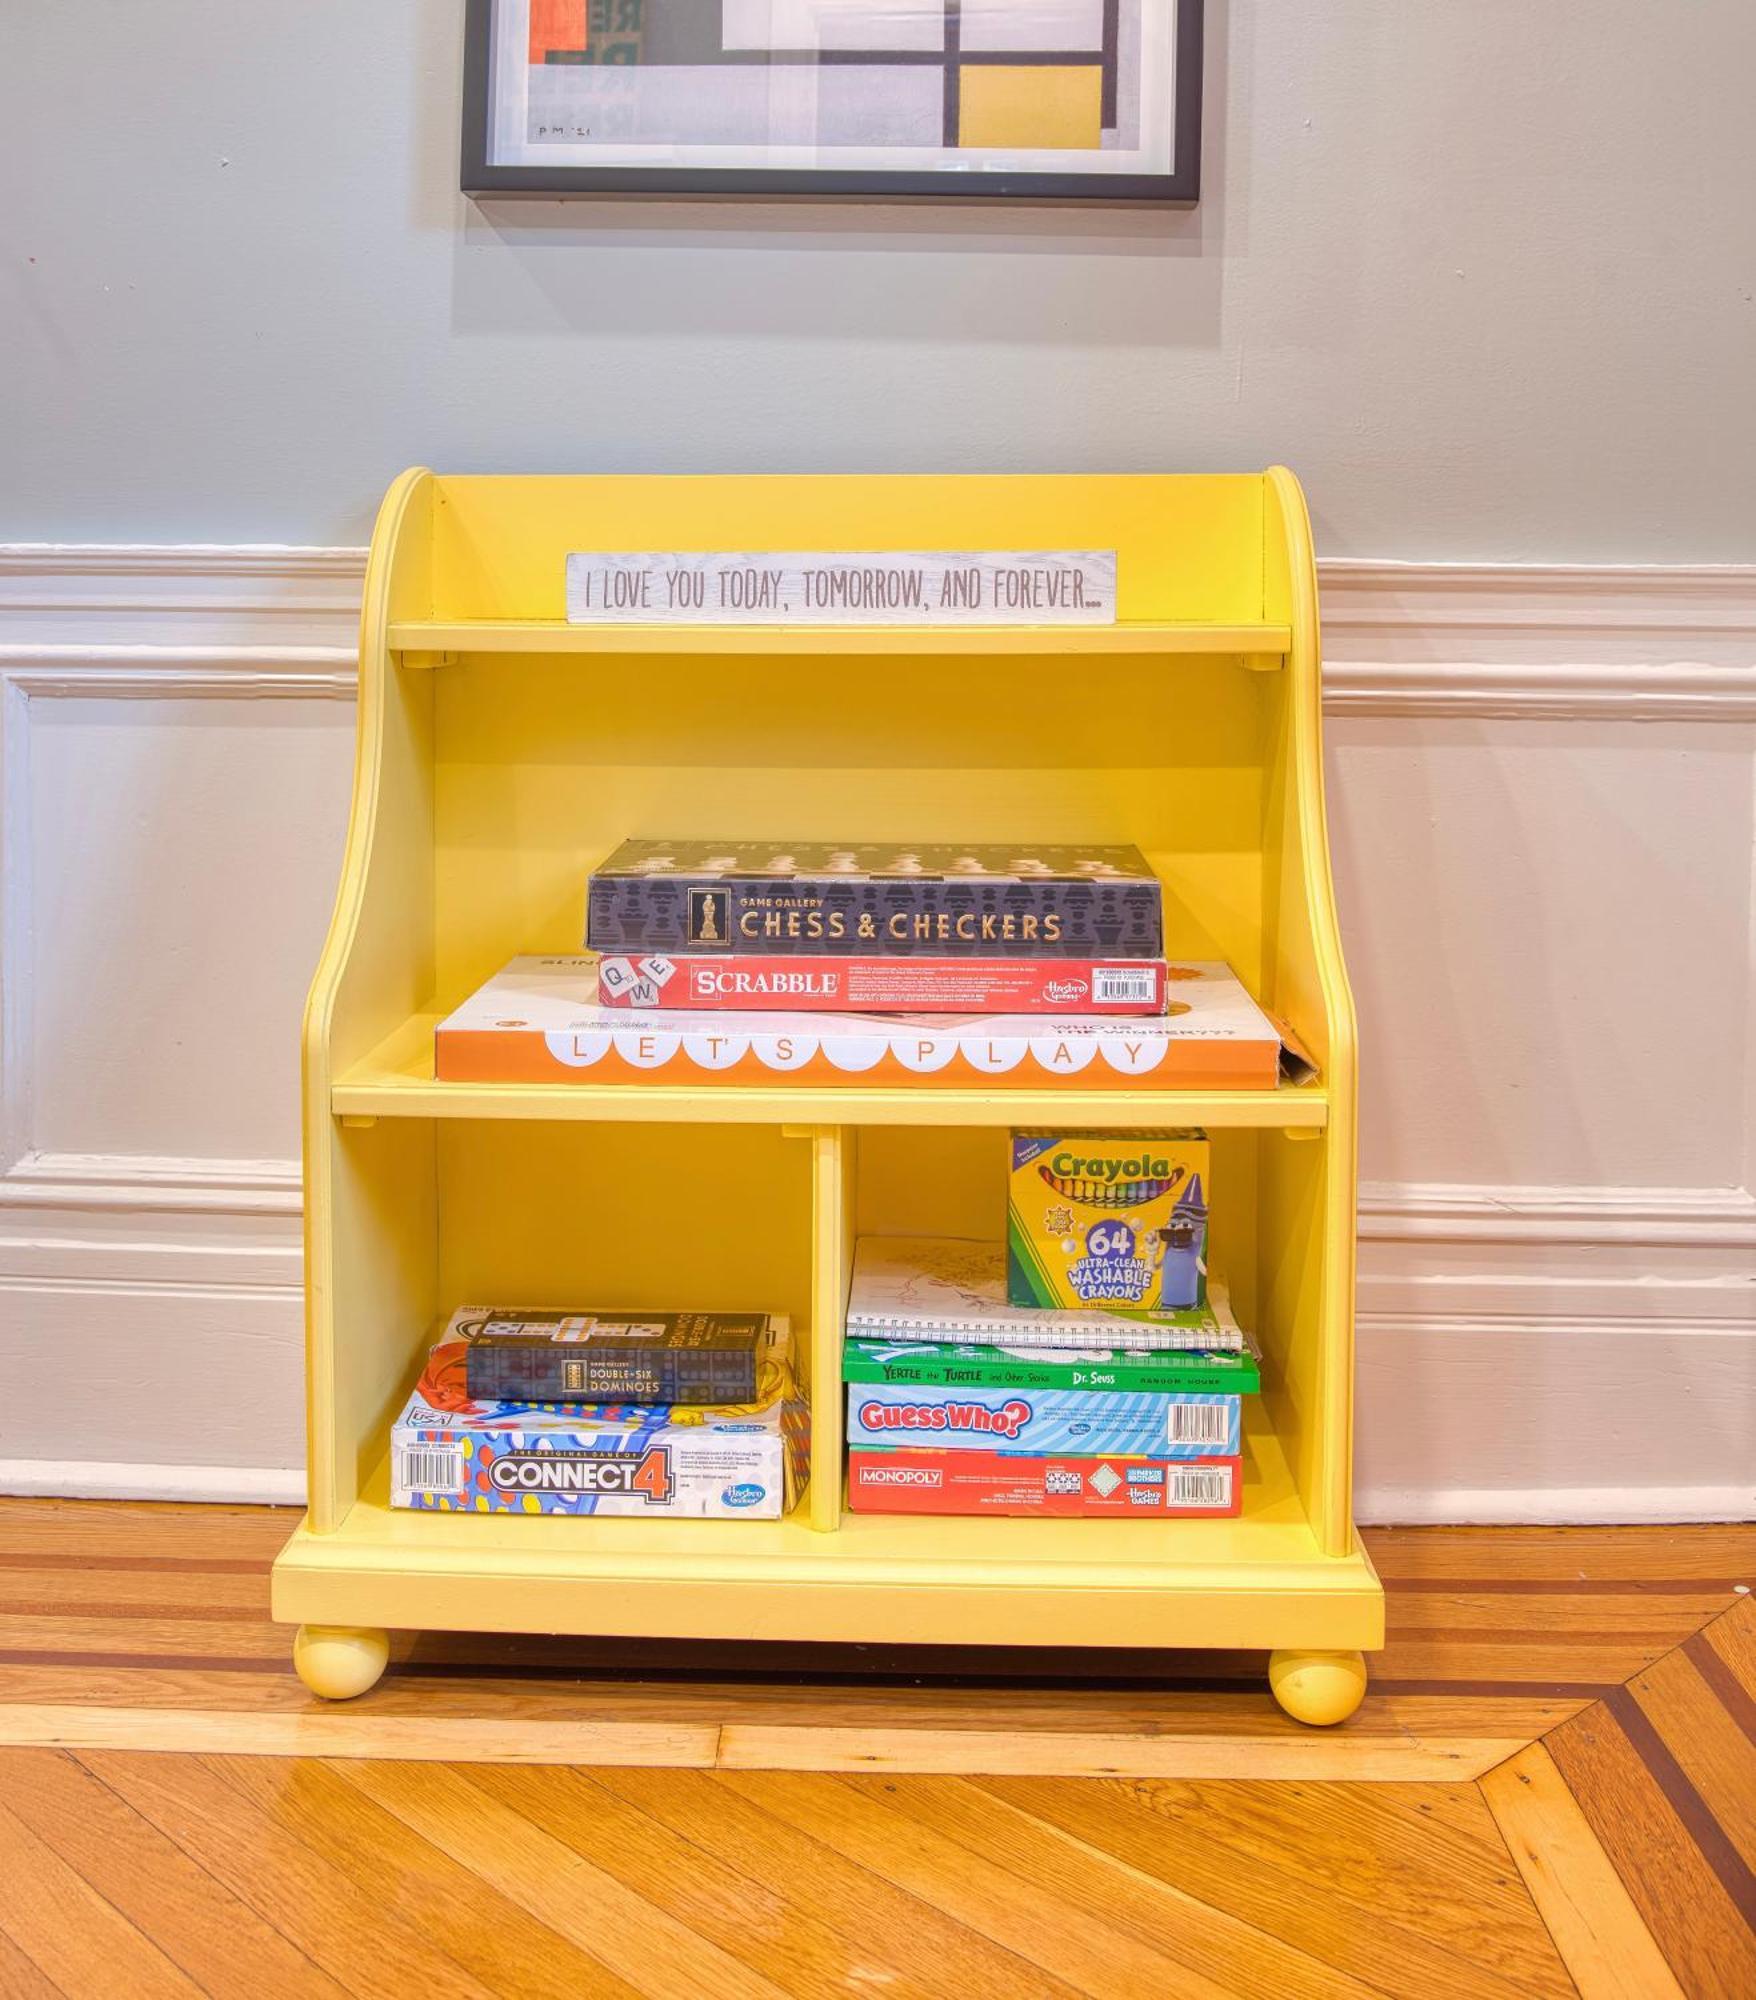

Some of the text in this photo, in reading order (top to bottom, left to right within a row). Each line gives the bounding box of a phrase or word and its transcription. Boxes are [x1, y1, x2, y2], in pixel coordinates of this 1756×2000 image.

[585, 568, 1101, 612] I LOVE YOU TODAY, TOMORROW, AND FOREVER...
[740, 898, 824, 908] GAME GALLERY
[740, 911, 1062, 941] CHESS & CHECKERS
[604, 967, 624, 986] Q
[648, 959, 666, 976] E
[631, 983, 651, 1000] W
[697, 971, 838, 994] SCRABBLE
[1053, 1152, 1170, 1184] Crayola
[1089, 1227, 1130, 1256] 64
[1078, 1257, 1145, 1269] ULTRA-CLEAN
[1068, 1268, 1152, 1288] WASHABLE
[1079, 1284, 1142, 1301] CRAYONS
[883, 1365, 921, 1380] YERTLE
[943, 1367, 983, 1382] TURTLE
[1072, 1372, 1088, 1385] Dr.
[1090, 1371, 1115, 1385] Seuss
[590, 1381, 660, 1393] DOMINOES
[862, 1402, 947, 1430] Guess
[946, 1402, 1031, 1438] Who?
[493, 1461, 637, 1490] CONNECT
[632, 1450, 669, 1499] 4
[863, 1471, 941, 1484] MONOPOLY
